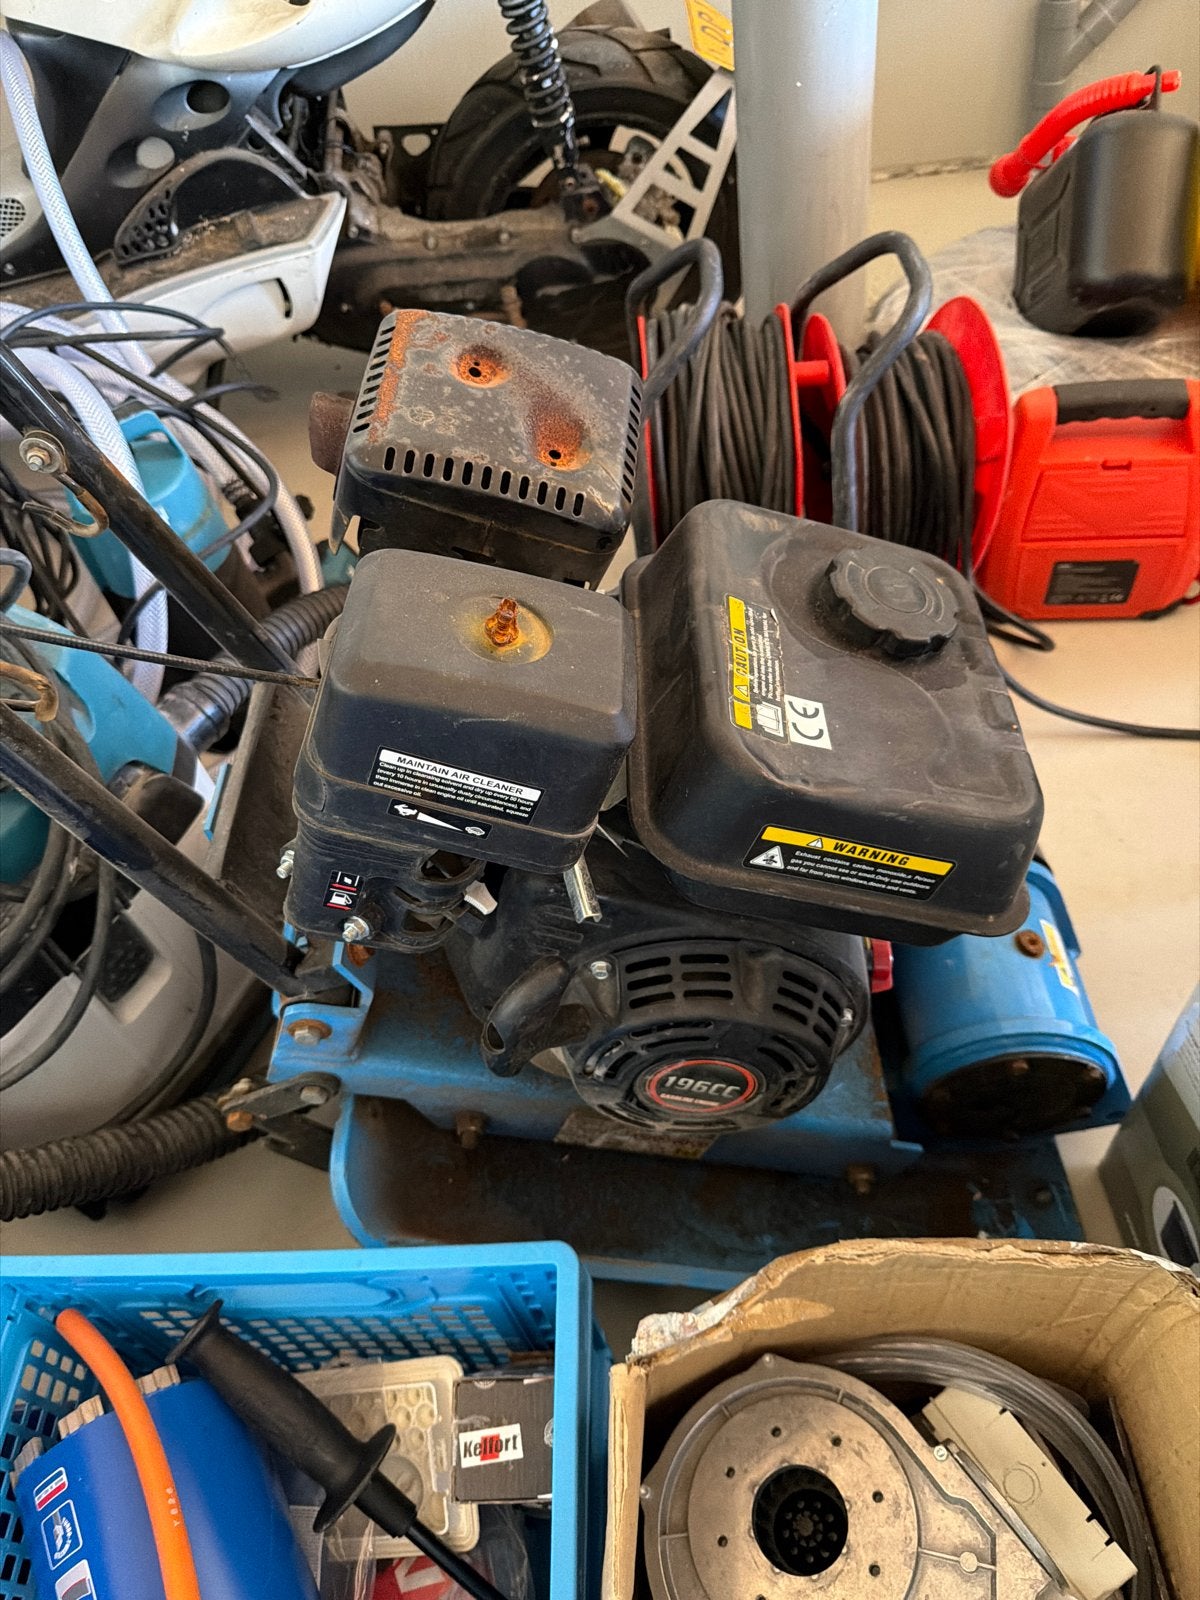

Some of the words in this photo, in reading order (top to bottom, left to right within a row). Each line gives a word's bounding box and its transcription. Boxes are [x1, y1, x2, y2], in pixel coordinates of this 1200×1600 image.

[733, 628, 747, 675] CAUTION
[788, 701, 824, 740] CE
[377, 768, 395, 777] (every
[404, 775, 421, 783] hours
[429, 782, 457, 793] unusually
[379, 761, 396, 770] Clean
[412, 771, 440, 782] cleansing
[441, 779, 462, 787] solvent
[493, 792, 509, 800] every
[517, 798, 533, 806] hours
[384, 784, 412, 794] excessive
[397, 757, 449, 775] MAINTAIN
[451, 771, 470, 781] AIR
[472, 777, 523, 794] CLEANER
[389, 778, 414, 788] immerse
[436, 791, 456, 799] engine
[506, 809, 528, 817] squeeze
[795, 850, 821, 859] Exhaust
[823, 857, 850, 865] contains
[852, 863, 874, 871] carbon
[913, 875, 935, 883] Poison
[834, 843, 909, 865] WARNING
[815, 863, 837, 871] cannot
[902, 881, 930, 889] outdoors
[666, 1076, 739, 1097] 196CC
